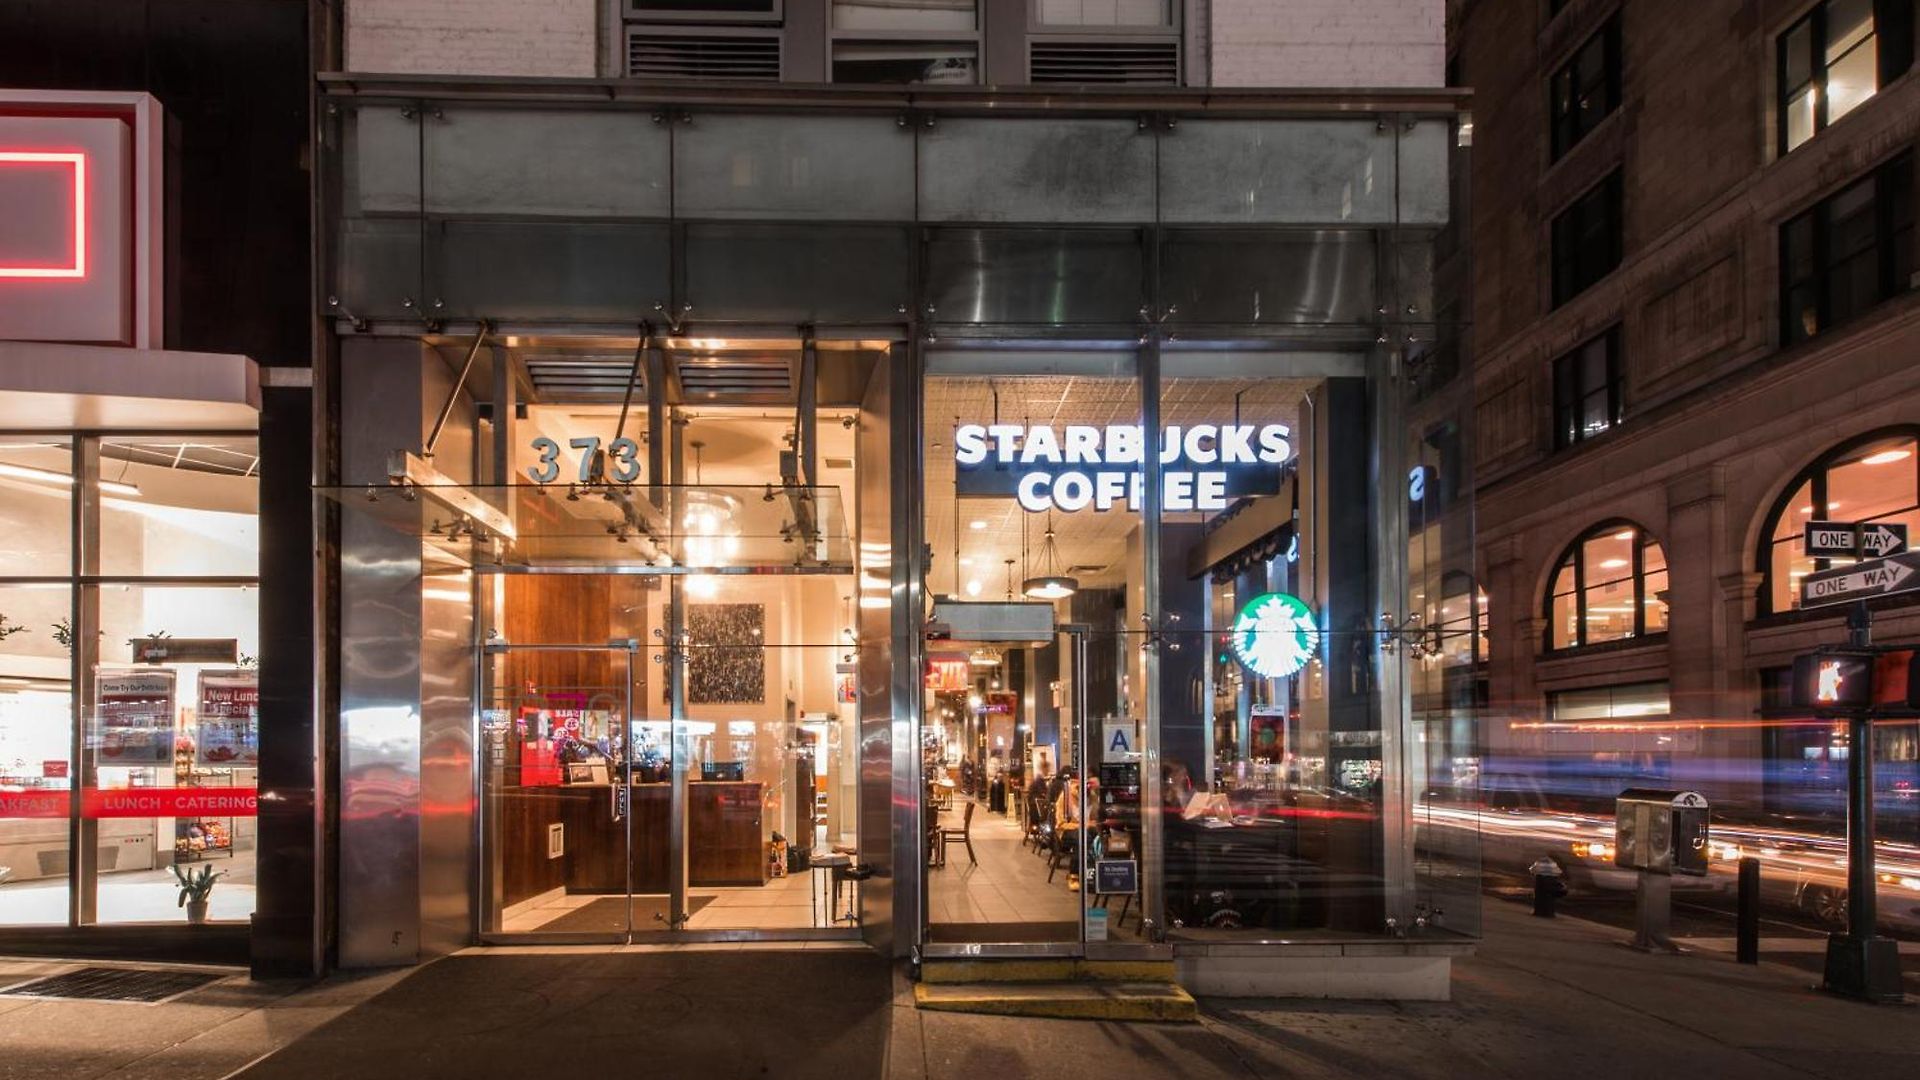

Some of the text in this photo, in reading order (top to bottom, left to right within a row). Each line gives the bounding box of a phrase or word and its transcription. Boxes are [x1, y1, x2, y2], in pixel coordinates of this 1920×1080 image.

[955, 424, 1291, 464] STARBUCKS
[528, 437, 641, 482] 373
[1819, 532, 1849, 547] ONE
[1815, 566, 1901, 596] ONE WAY
[120, 684, 129, 693] Try
[208, 689, 259, 701] New Lunc
[1110, 729, 1130, 752] A
[104, 795, 258, 809] LUNCH CATERING
